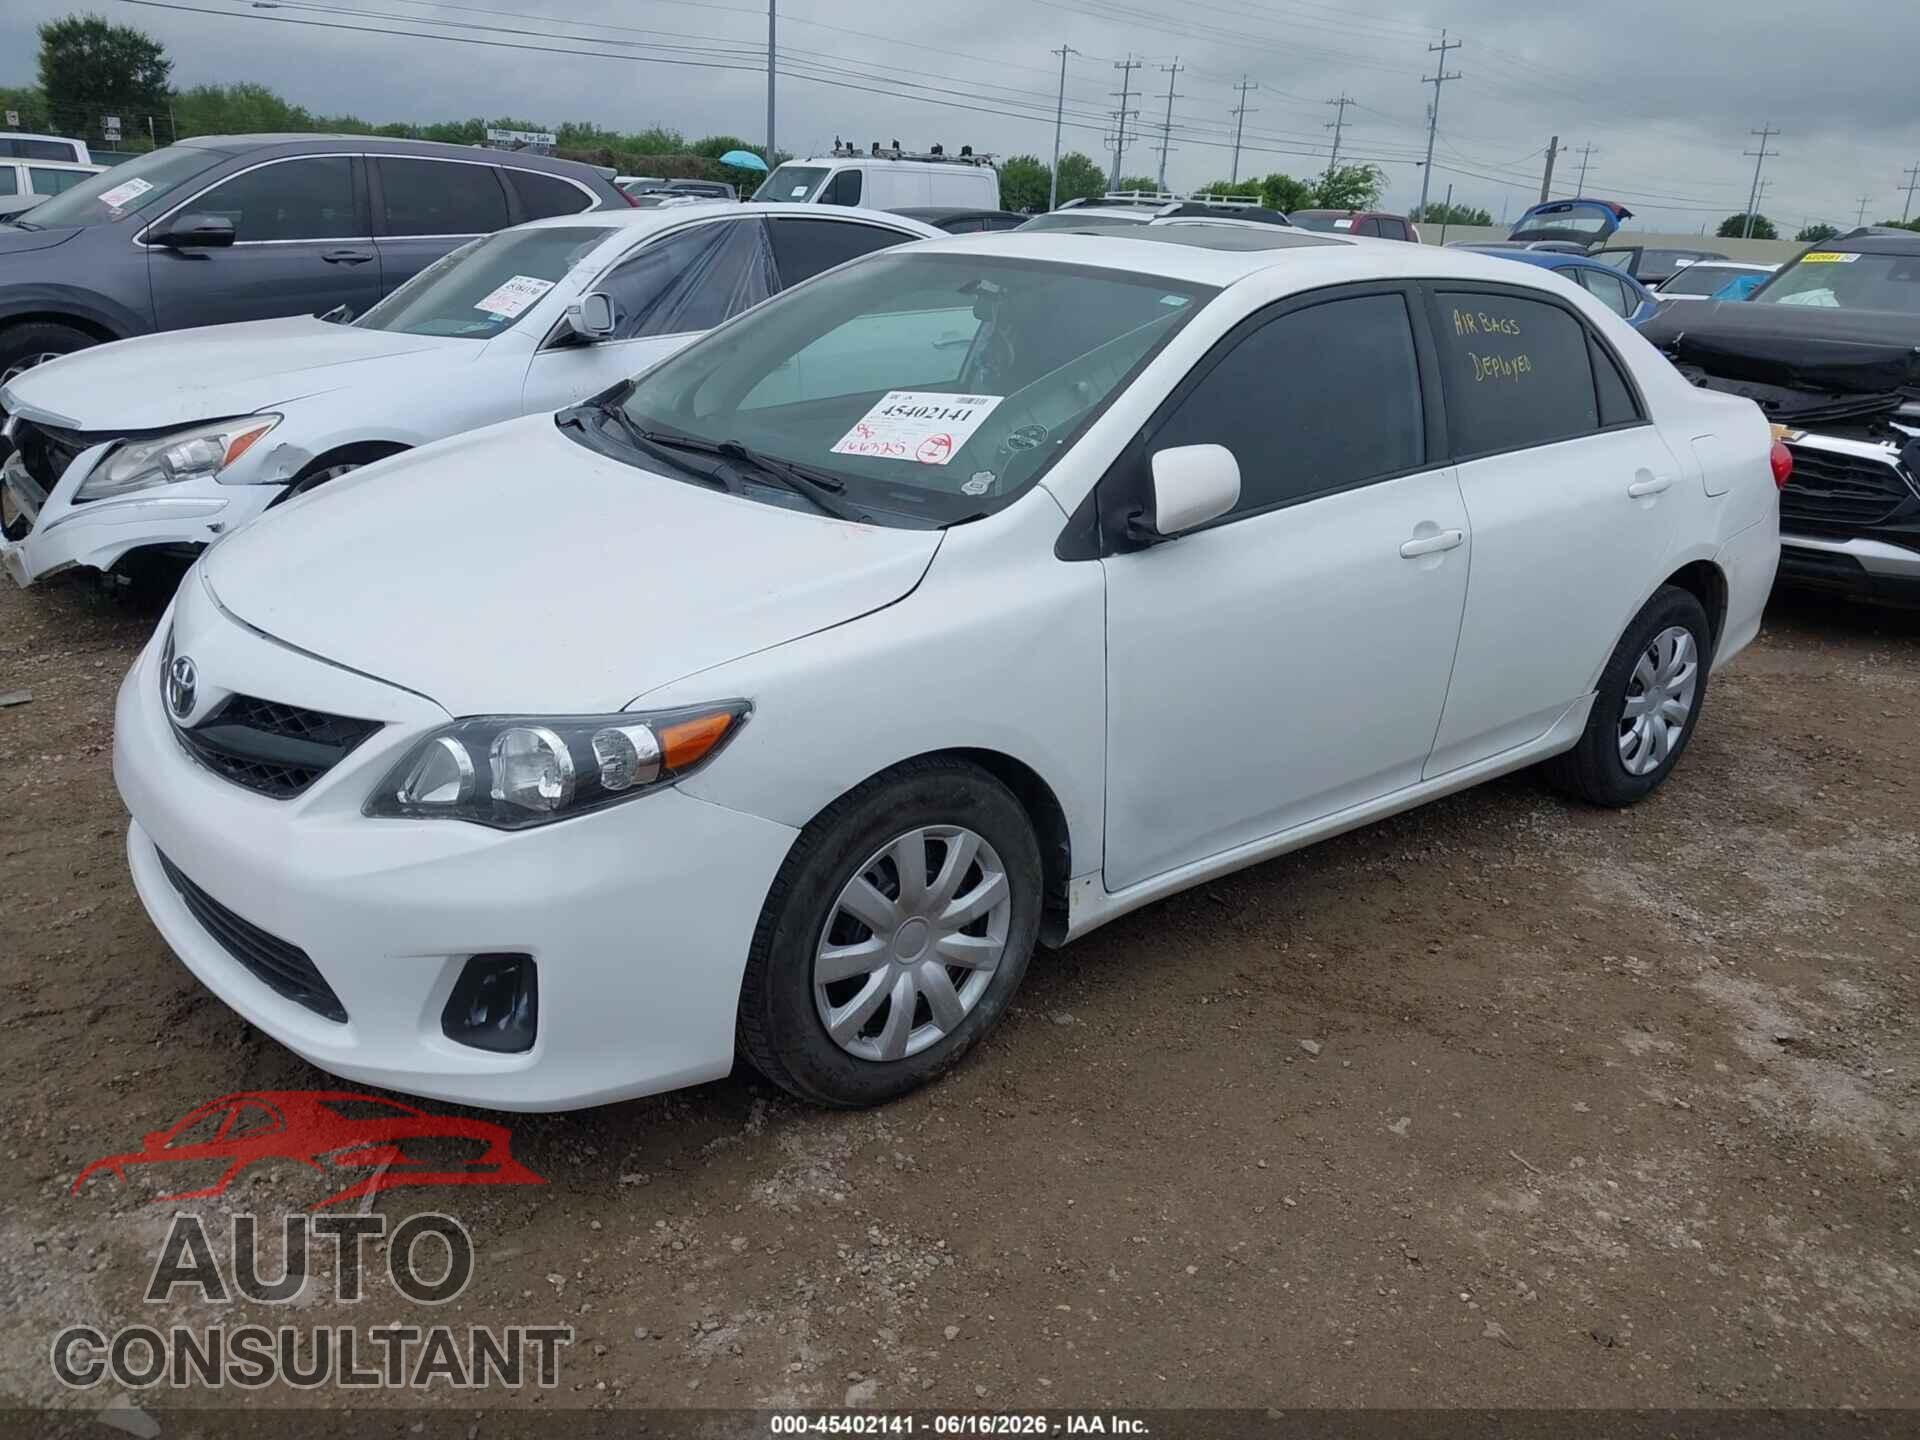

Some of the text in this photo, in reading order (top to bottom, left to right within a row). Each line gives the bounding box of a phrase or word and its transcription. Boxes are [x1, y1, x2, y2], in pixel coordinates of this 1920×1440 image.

[1453, 309, 1521, 337] AIR BAGS
[881, 404, 973, 421] 45402141
